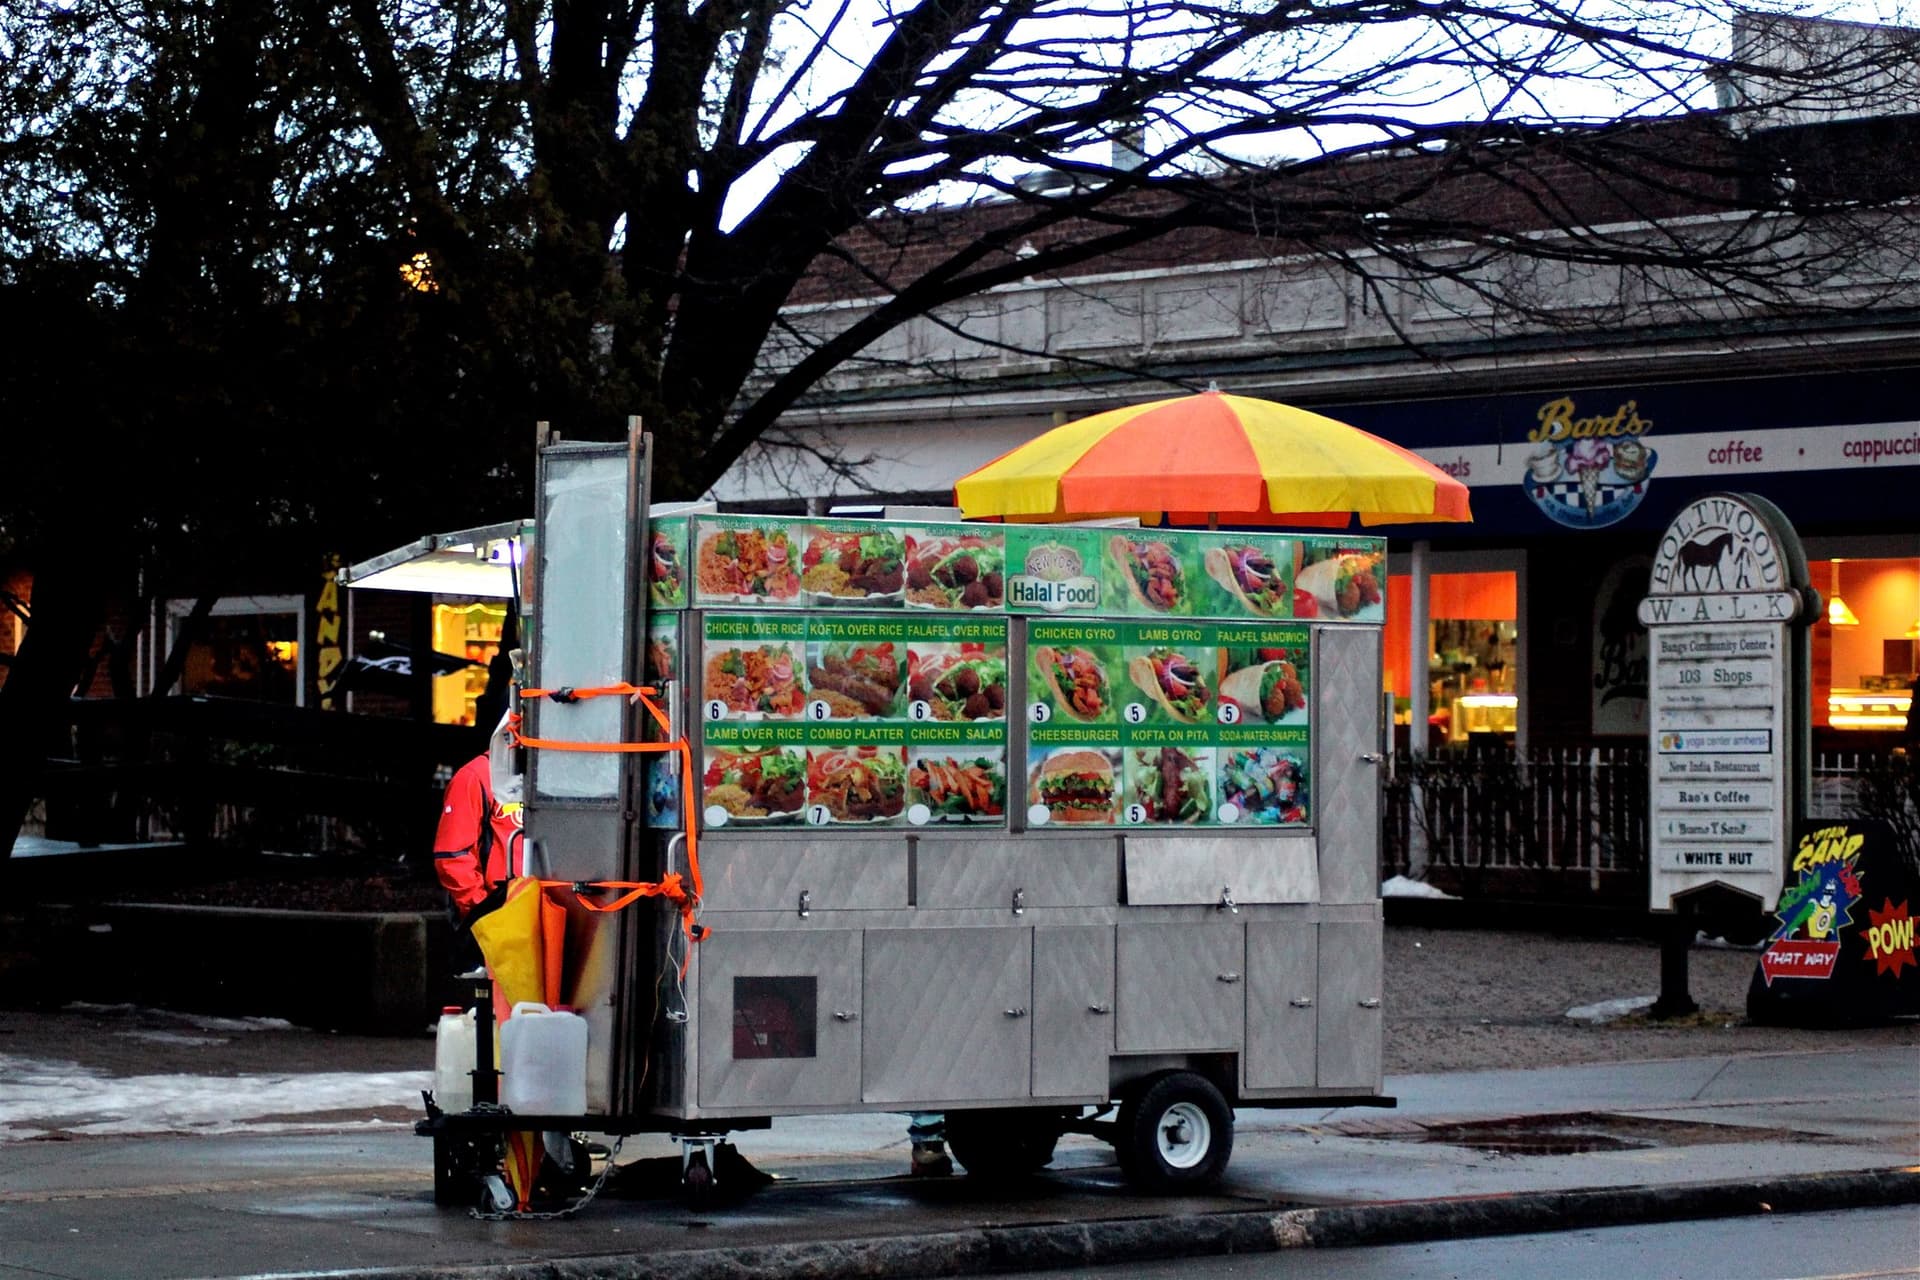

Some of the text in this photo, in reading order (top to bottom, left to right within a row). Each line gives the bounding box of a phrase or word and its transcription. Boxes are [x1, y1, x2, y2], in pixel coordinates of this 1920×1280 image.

[1528, 396, 1653, 442] Bart's
[1708, 440, 1763, 464] coffee
[1654, 501, 1779, 585] BOLTWOOD
[1028, 554, 1078, 573] NEW YORK
[1013, 582, 1096, 602] Halal Food
[705, 622, 803, 634] CHICKEN OVER RICE
[810, 624, 903, 636] KOFTA OVER RICE
[908, 625, 1006, 637] FALAFEL OVER RICE
[1034, 628, 1116, 640] CHICKEN GYRO
[1138, 629, 1202, 641] LAMB GYRO
[1217, 631, 1309, 643] FALAFEL SANDWICH
[1689, 639, 1738, 654] Community
[1740, 638, 1767, 651] Center
[1679, 668, 1753, 685] 103 Shops
[711, 702, 719, 720] 6
[815, 702, 824, 720] 6
[915, 702, 924, 720] 6
[1035, 705, 1044, 721] 5
[1131, 705, 1140, 722] 5
[1225, 705, 1233, 722] 5
[706, 728, 803, 740] LAMB OVER RICE
[809, 728, 904, 740] COMBO PLATTER
[910, 728, 1003, 740] CHICKEN SALAD
[1031, 729, 1119, 741] CHEESEBURGER
[1131, 729, 1209, 741] KOFTA ON PITA
[1669, 760, 1760, 773] New India Restaurant
[1679, 791, 1751, 803] Rao's Coffee
[815, 807, 822, 824] 7
[1130, 806, 1139, 823] 5
[1684, 852, 1753, 865] WHITE HUT
[1868, 916, 1914, 959] POW!
[1766, 951, 1835, 966] THAT WAY
